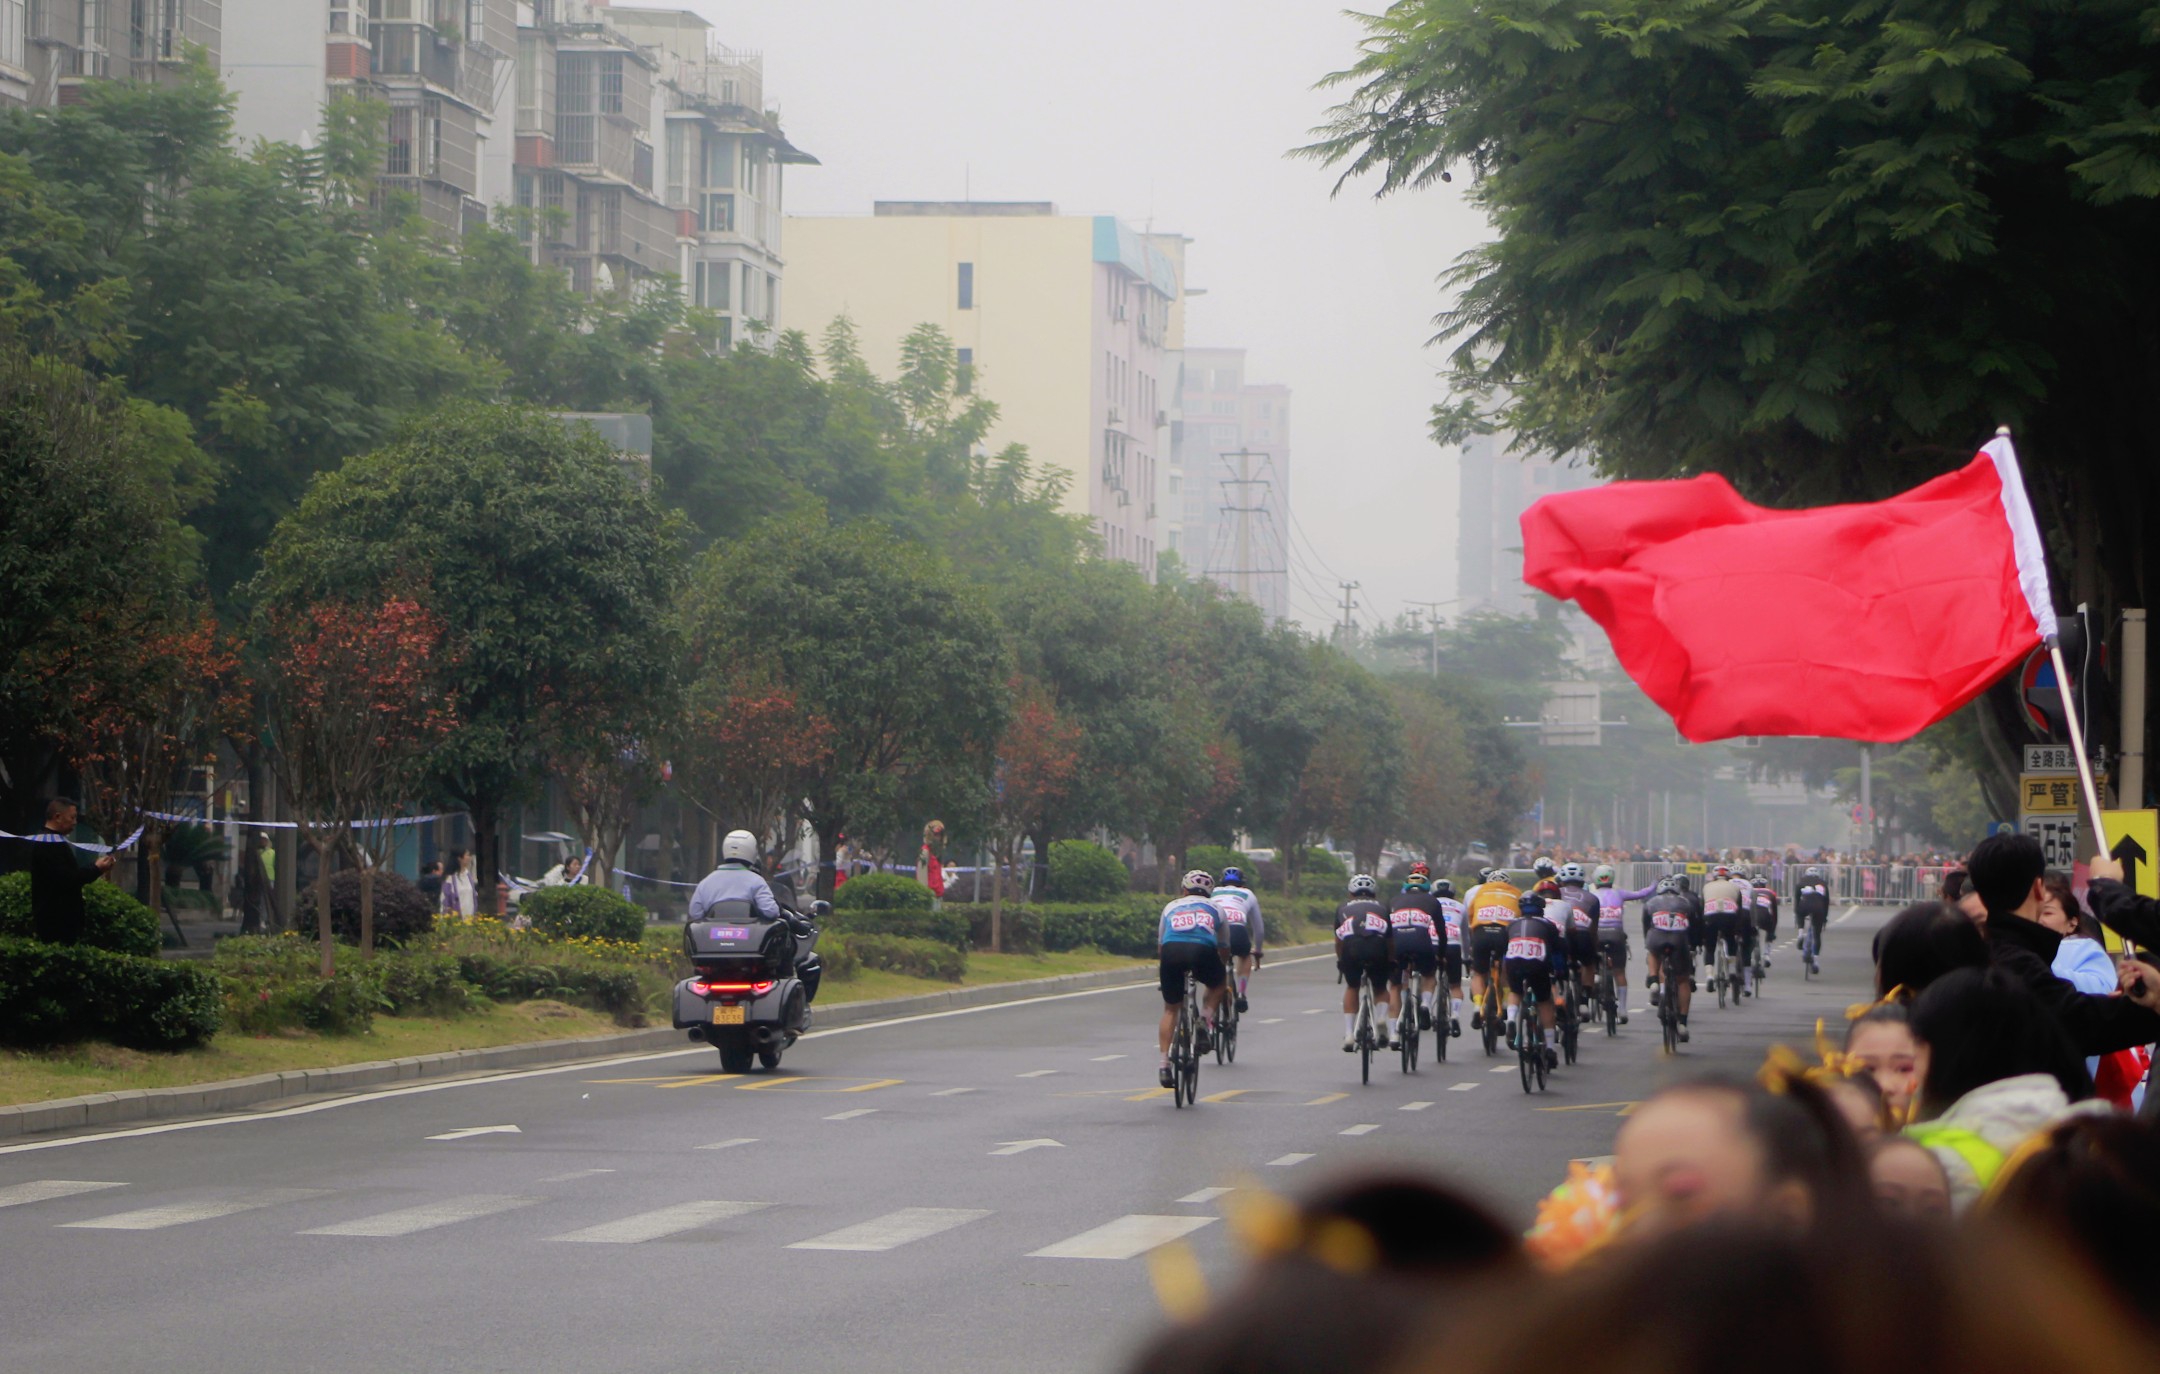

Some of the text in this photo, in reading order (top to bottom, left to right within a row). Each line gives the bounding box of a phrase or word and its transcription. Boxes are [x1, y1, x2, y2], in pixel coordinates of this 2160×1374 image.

[2031, 750, 2103, 768] 全路段禁停
[1173, 916, 1194, 928] 238
